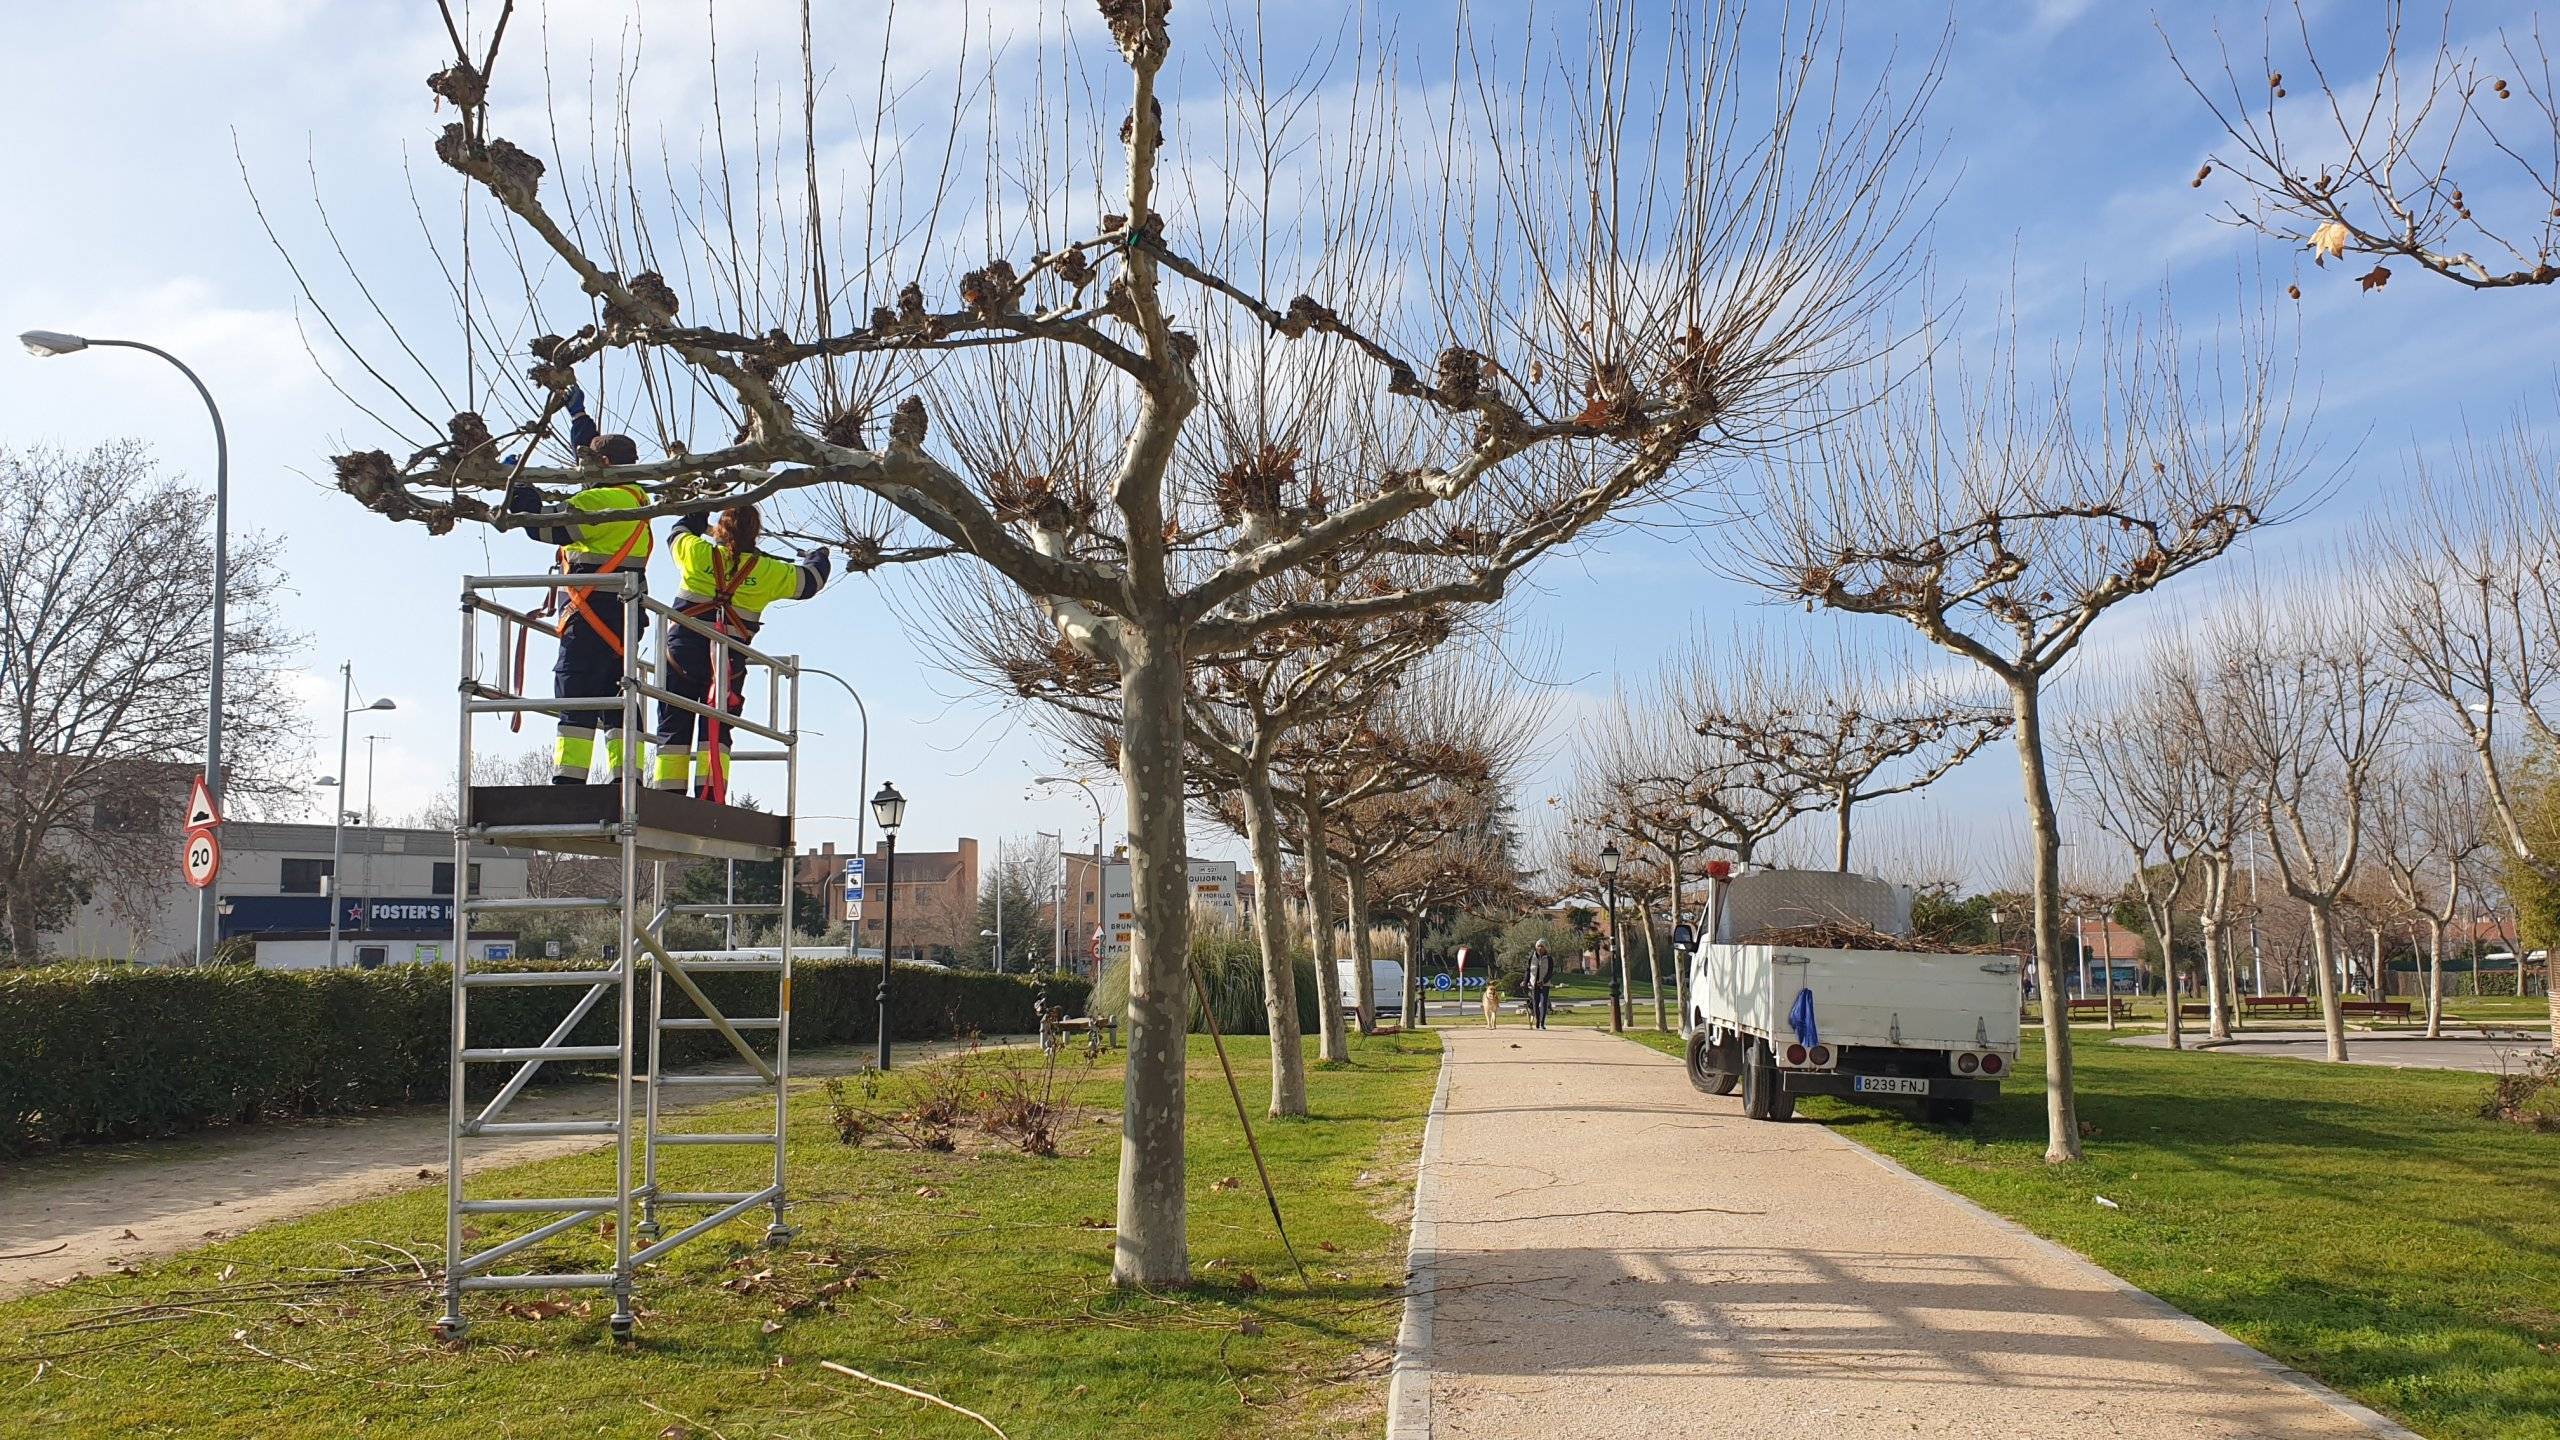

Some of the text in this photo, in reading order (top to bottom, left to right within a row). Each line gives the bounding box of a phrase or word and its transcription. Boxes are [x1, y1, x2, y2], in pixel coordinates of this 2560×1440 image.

[192, 848, 209, 868] 20
[371, 904, 441, 919] FOSTER'S
[1108, 945, 1131, 953] MAD
[1864, 1078, 1925, 1093] 8239 FNJ
